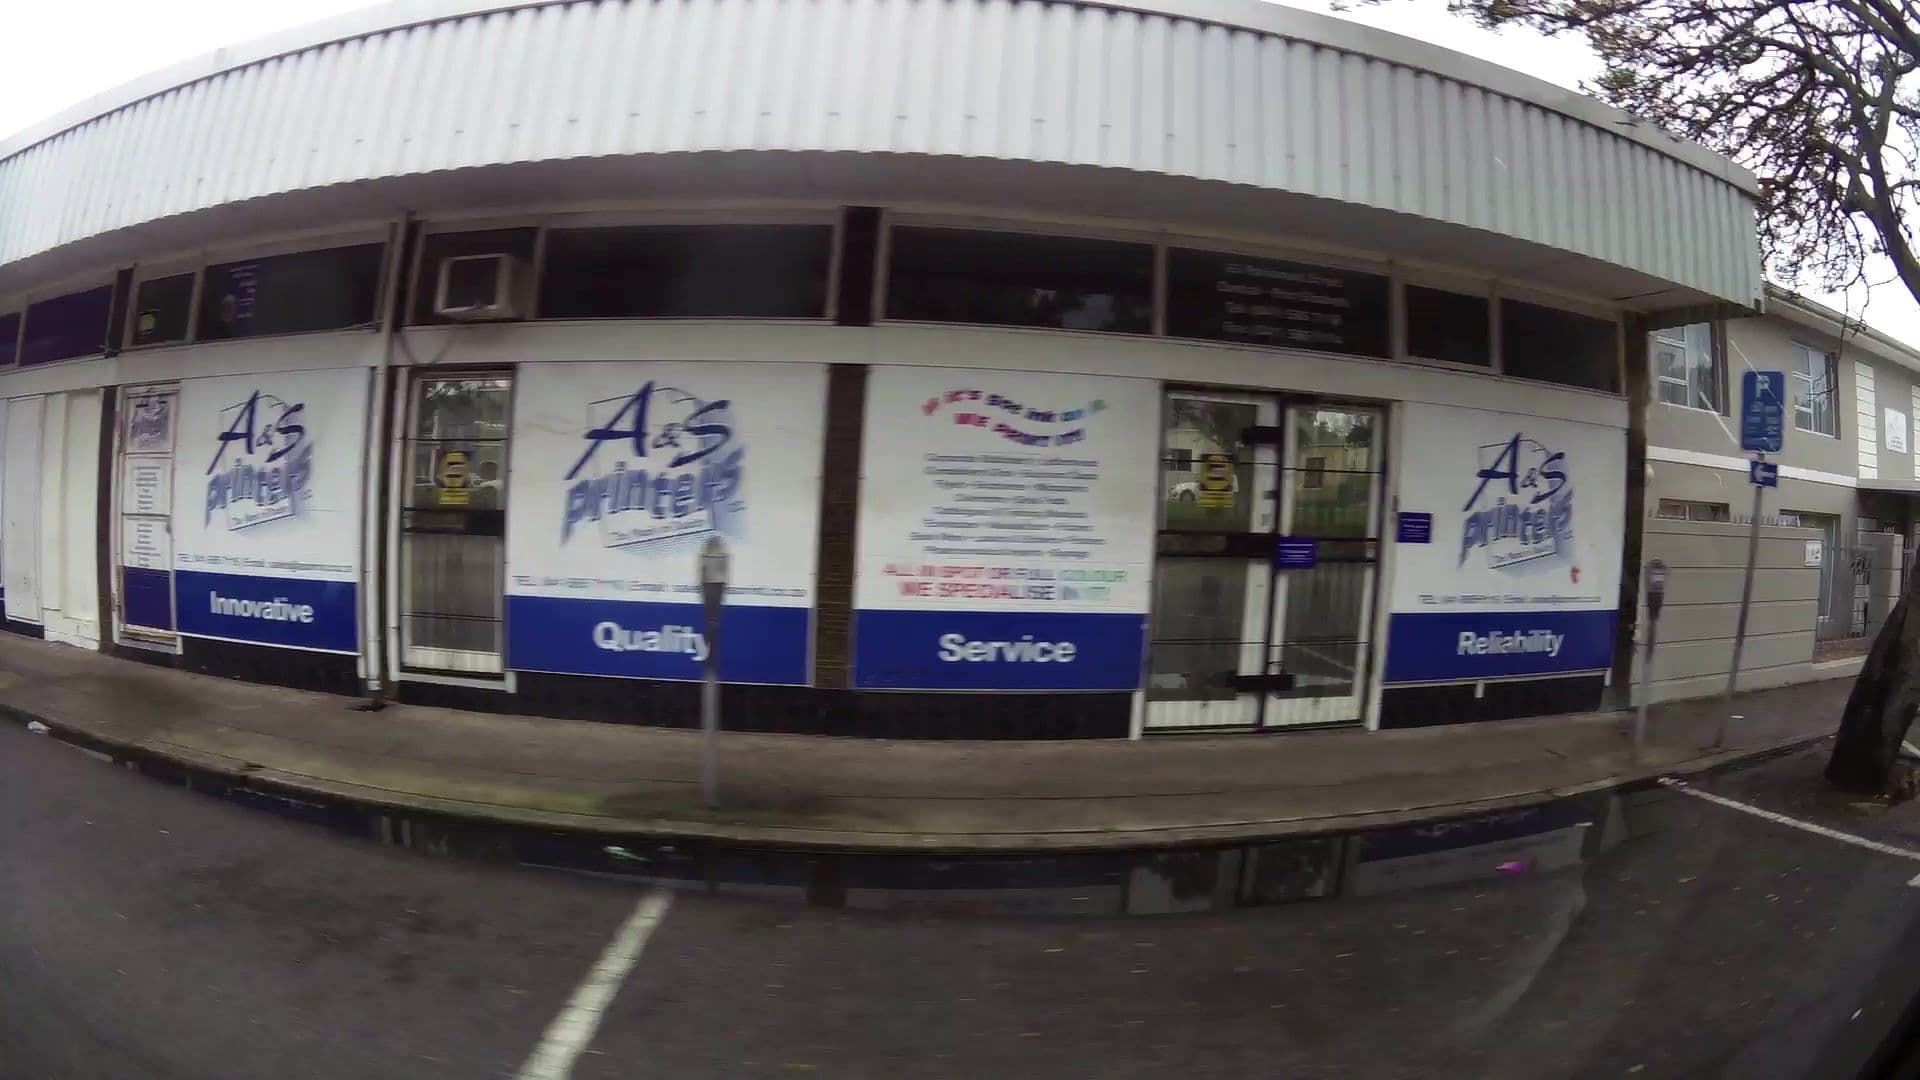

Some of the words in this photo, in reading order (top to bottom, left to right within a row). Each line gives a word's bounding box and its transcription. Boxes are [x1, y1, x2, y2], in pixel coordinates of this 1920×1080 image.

[1755, 375, 1769, 398] P
[206, 389, 305, 475] A&S
[564, 380, 731, 480] A&S
[1463, 432, 1566, 512] A&S
[210, 590, 314, 625] Innovative
[592, 621, 711, 661] Quality
[938, 633, 1076, 664] Service
[1457, 631, 1566, 657] Reliability
